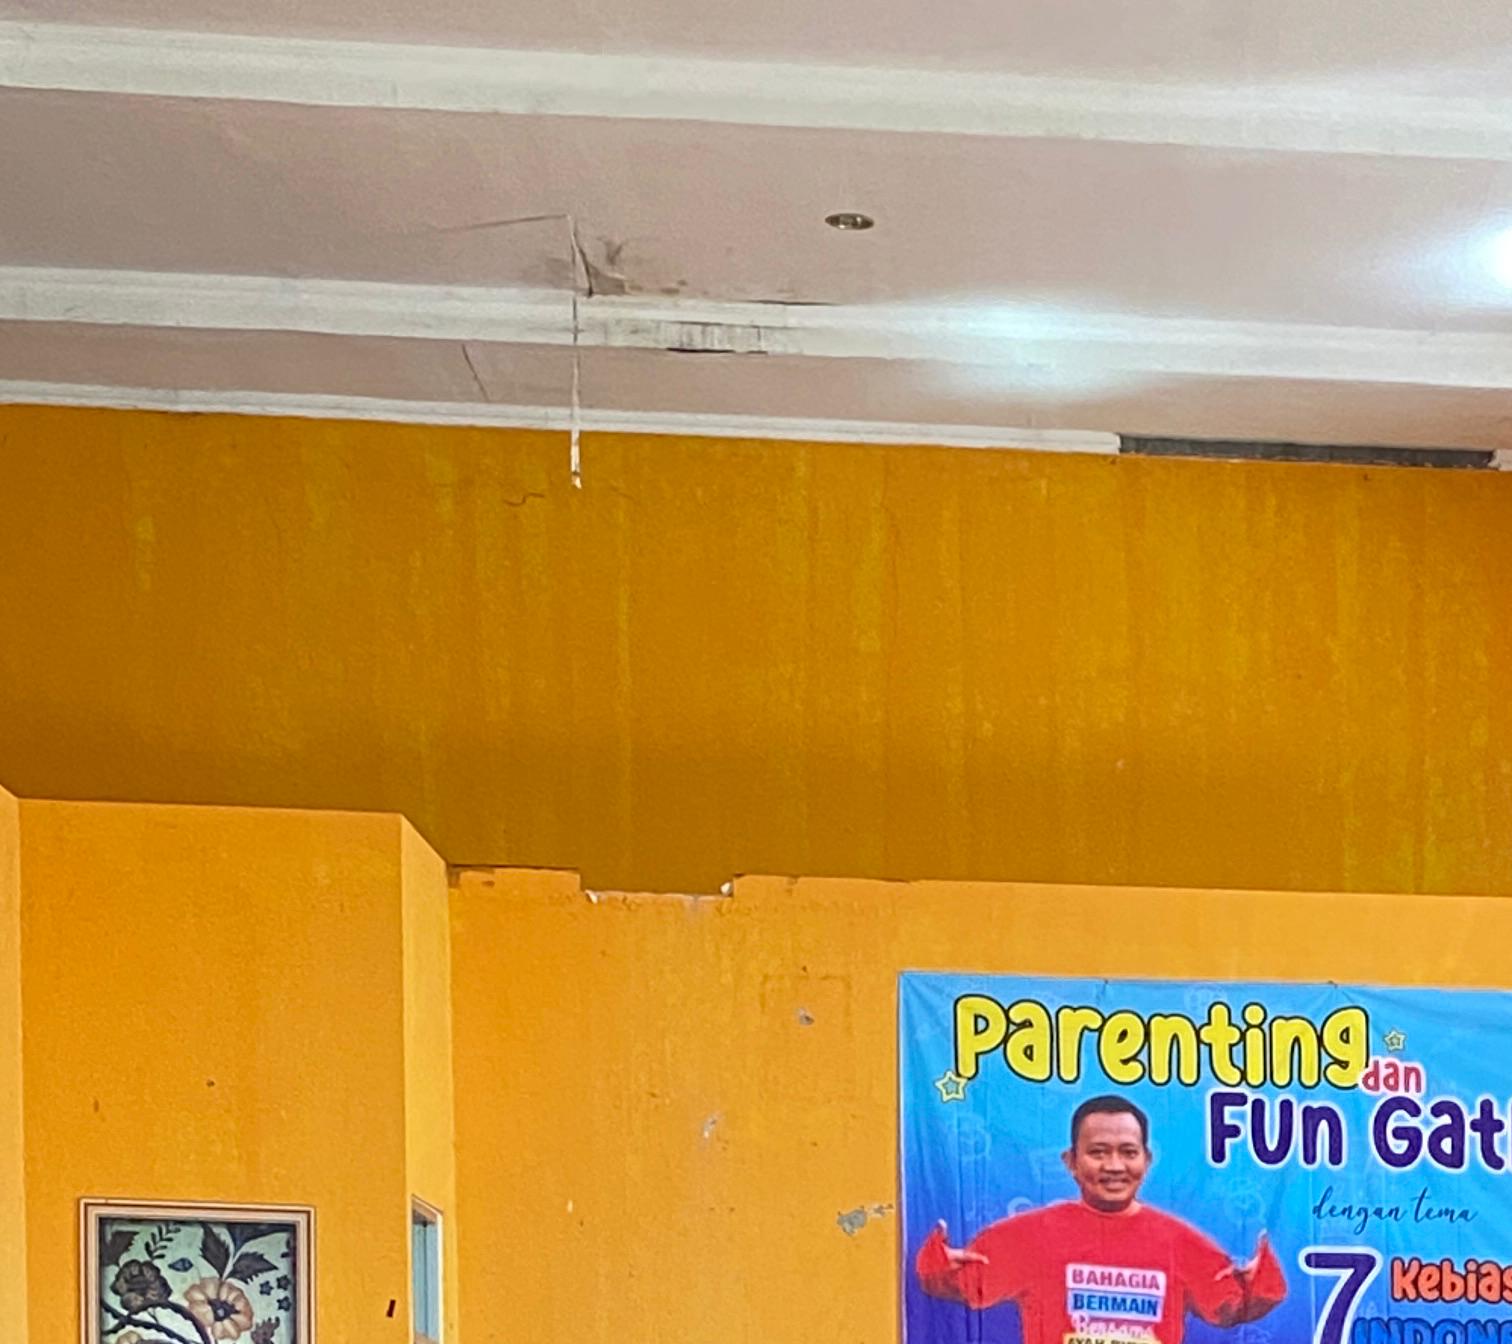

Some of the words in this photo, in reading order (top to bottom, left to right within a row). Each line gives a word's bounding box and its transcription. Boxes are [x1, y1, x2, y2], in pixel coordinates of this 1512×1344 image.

[954, 994, 1369, 1090] Parenting
[1361, 1059, 1422, 1093] dan
[1312, 1186, 1404, 1236] dengan
[1408, 1187, 1478, 1223] tema
[1072, 1269, 1160, 1291] BAHAGIA
[1072, 1293, 1158, 1317] BERMAIN
